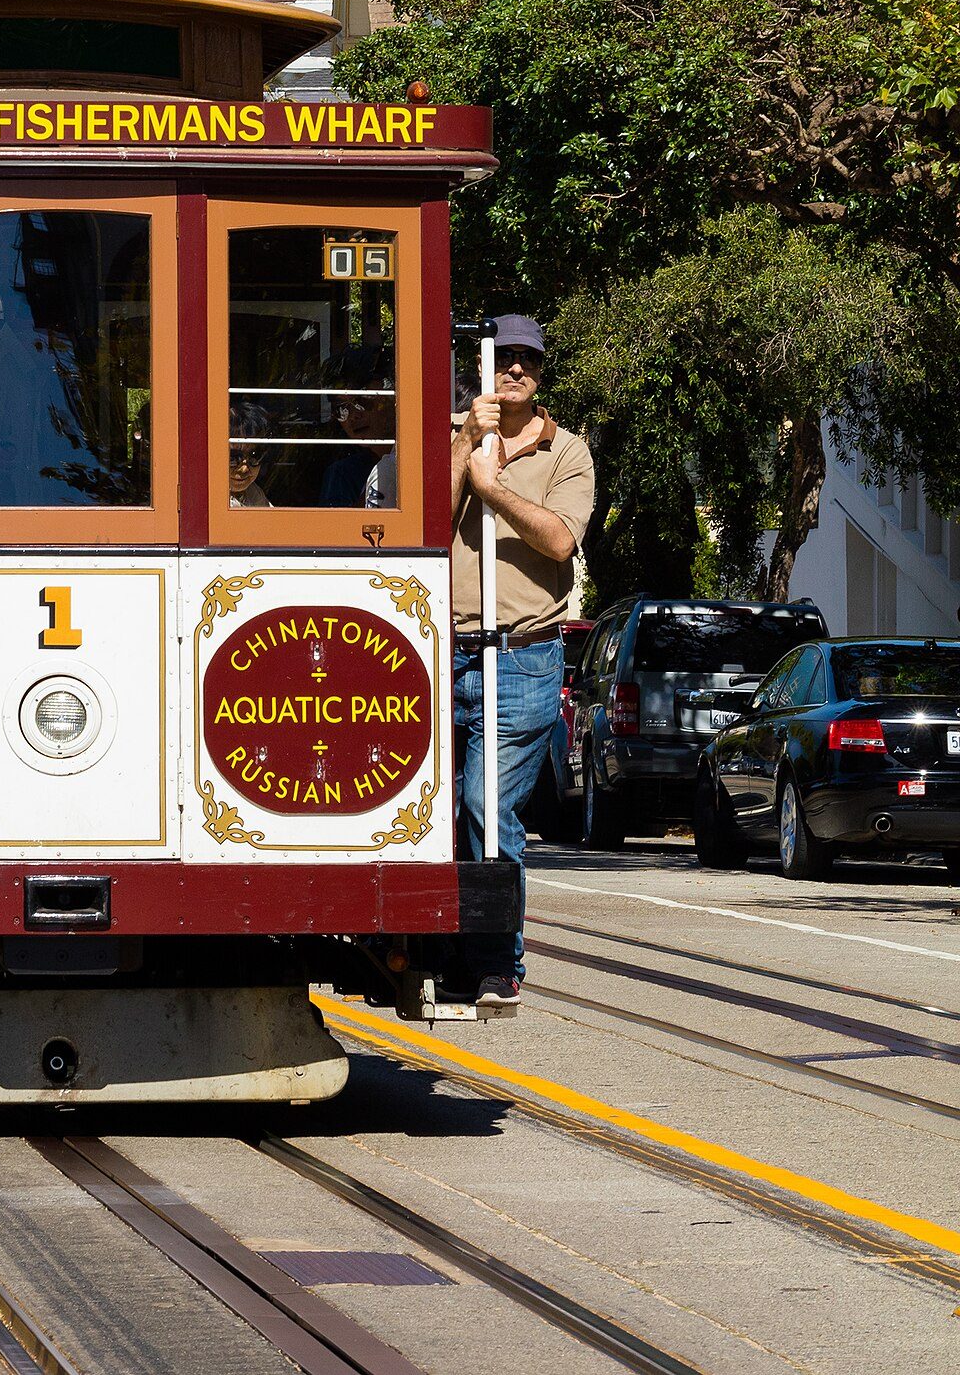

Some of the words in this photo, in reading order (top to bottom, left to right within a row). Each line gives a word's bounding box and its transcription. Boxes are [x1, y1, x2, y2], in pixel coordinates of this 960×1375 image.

[284, 105, 438, 143] WHARF
[330, 247, 387, 278] 05
[38, 586, 82, 650] 1
[229, 616, 408, 674] CHINATOWN
[213, 695, 343, 725] AQUATIC
[351, 695, 422, 723] PARK
[225, 745, 342, 805] RUSSIAN
[353, 749, 413, 800] HILL
